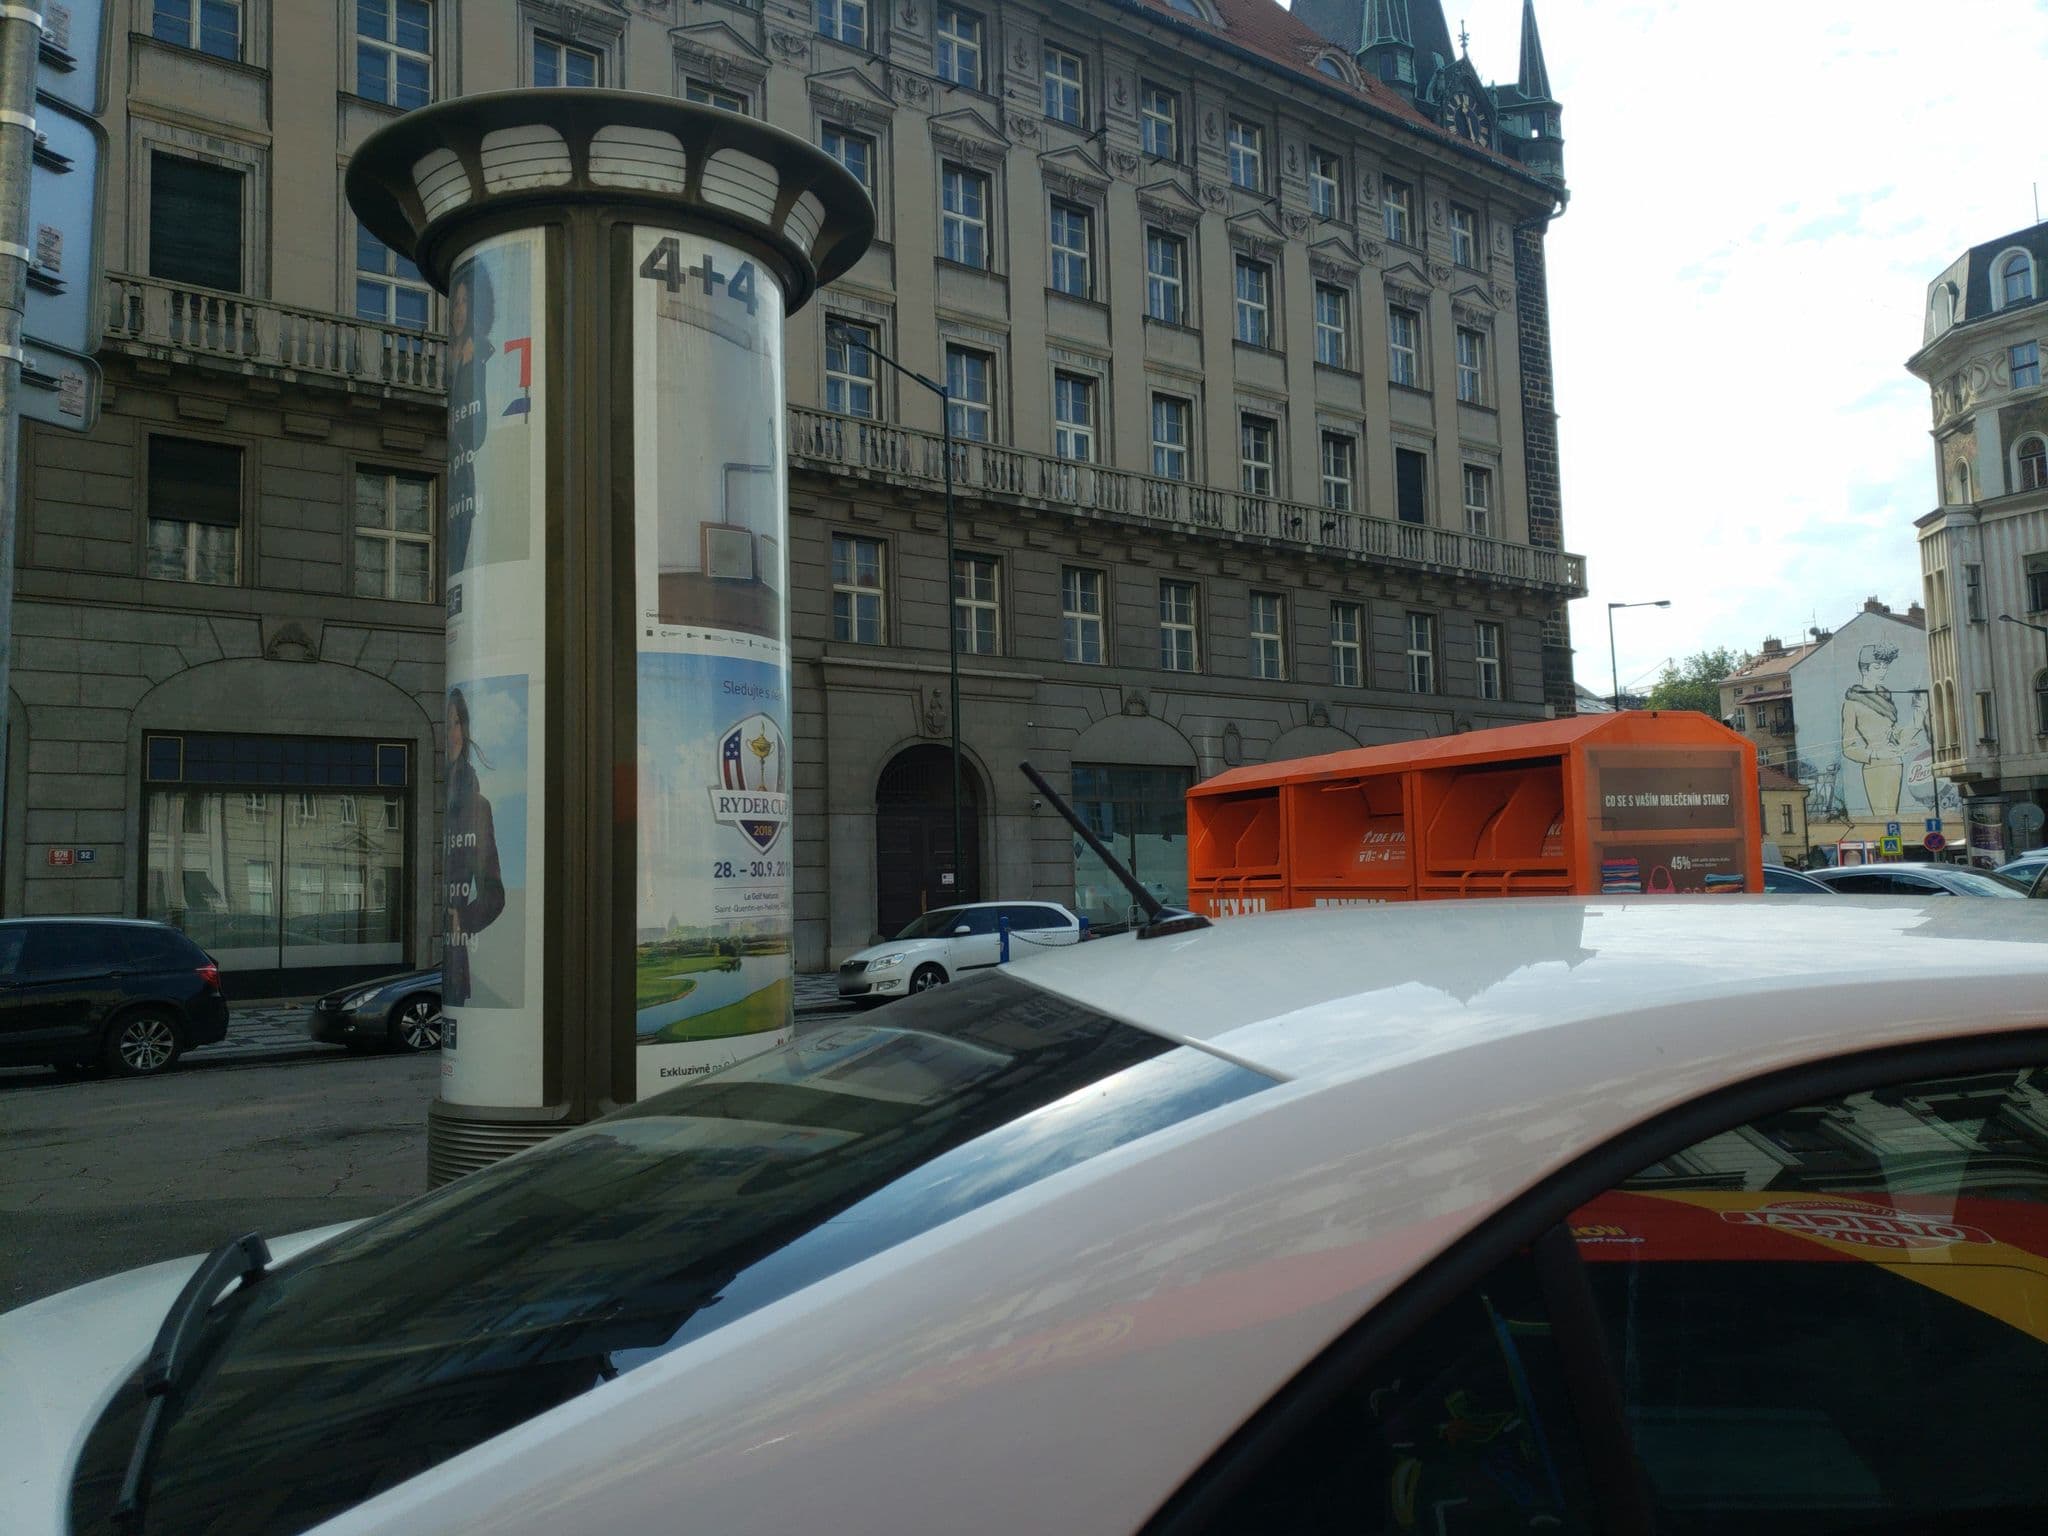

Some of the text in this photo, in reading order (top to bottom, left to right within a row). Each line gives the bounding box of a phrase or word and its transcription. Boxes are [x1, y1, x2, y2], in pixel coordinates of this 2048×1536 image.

[639, 236, 759, 317] 4+4
[723, 680, 764, 700] Sledujte
[719, 797, 769, 814] RYDER
[1605, 792, 1730, 807] CO SE S VAŠÍM OBLEČENÍM STANE?
[754, 825, 773, 836] 2018
[81, 851, 91, 859] 32
[1671, 856, 1692, 870] 45%
[714, 861, 736, 878] 28.
[449, 881, 470, 904] pro
[660, 1063, 711, 1078] Exkluzivně
